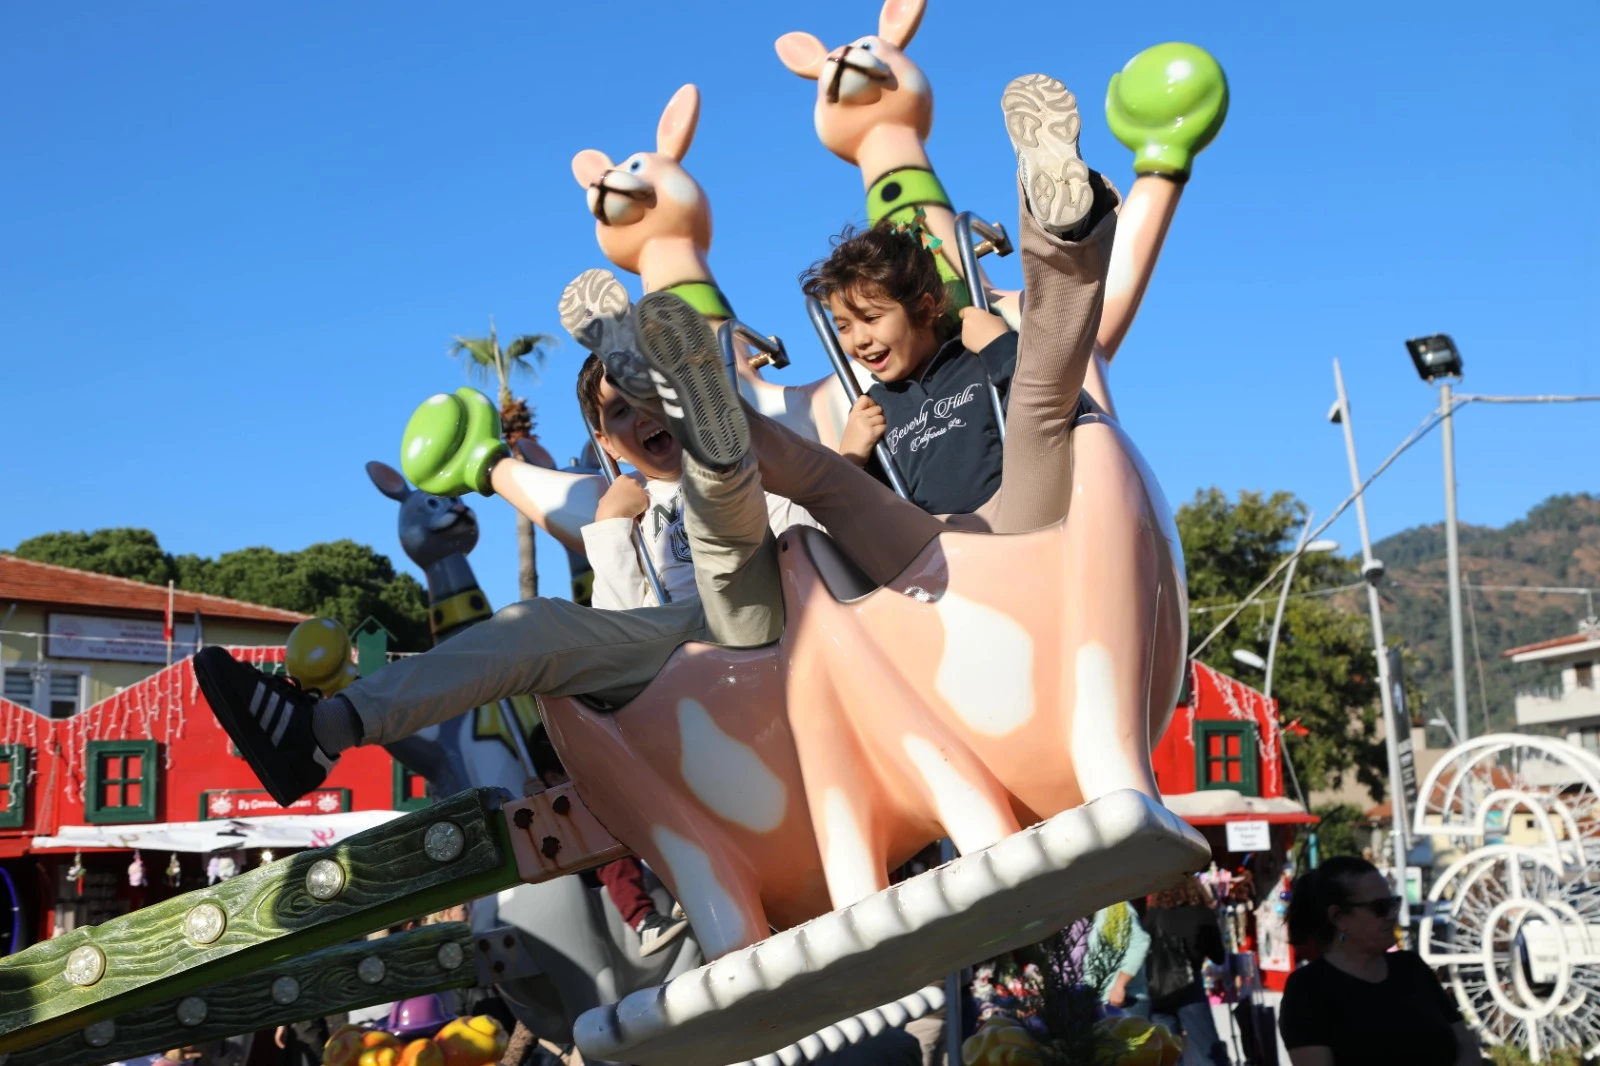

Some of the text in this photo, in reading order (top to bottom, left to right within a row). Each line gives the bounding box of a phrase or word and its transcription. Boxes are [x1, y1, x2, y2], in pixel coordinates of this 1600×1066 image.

[886, 382, 982, 455] Beverly Hills
[909, 426, 947, 452] California
